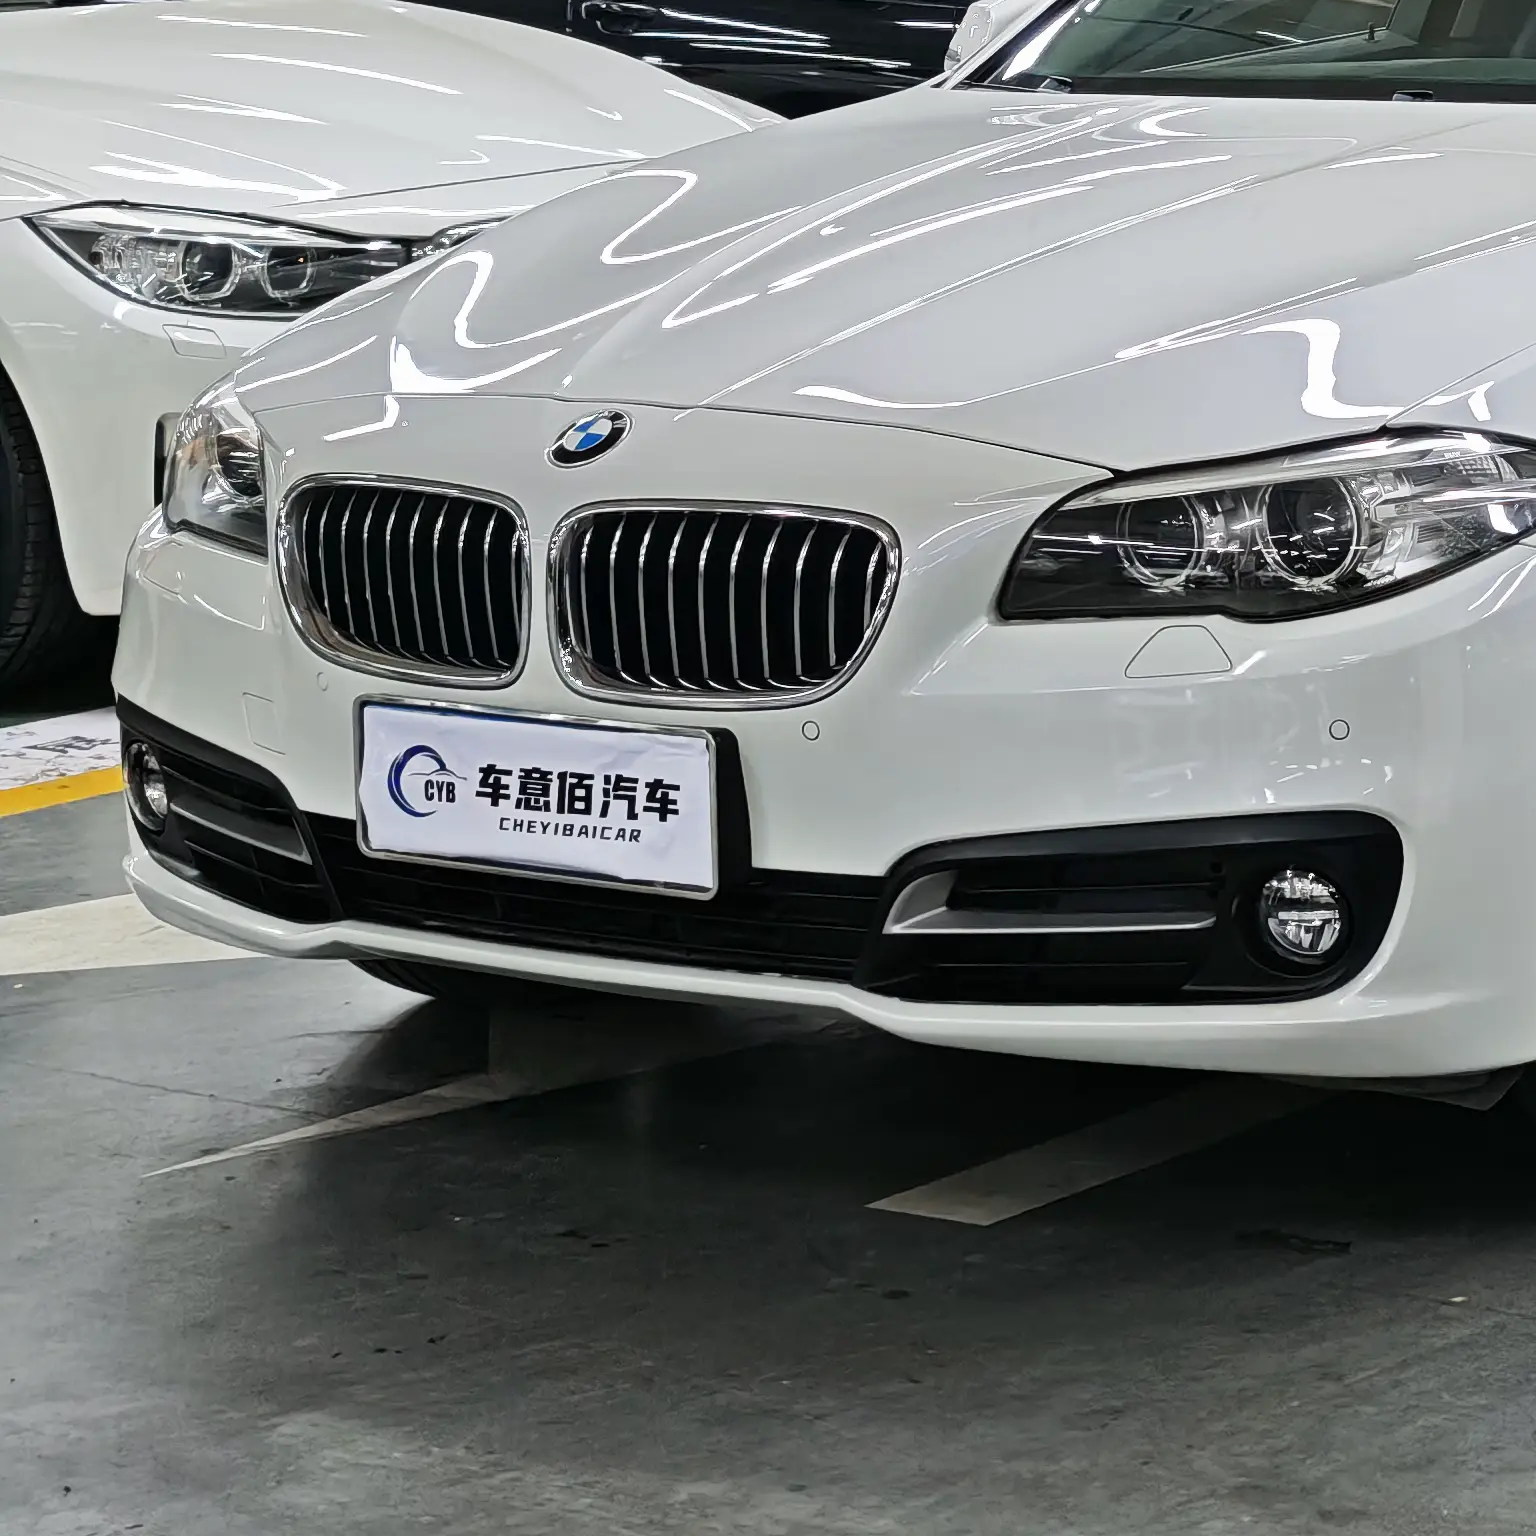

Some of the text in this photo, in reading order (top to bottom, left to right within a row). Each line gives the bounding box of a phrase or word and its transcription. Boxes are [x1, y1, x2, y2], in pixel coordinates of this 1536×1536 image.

[424, 779, 456, 803] CYB
[474, 763, 681, 823] 车意佰汽车
[499, 817, 642, 843] CHEYIBAICAR
